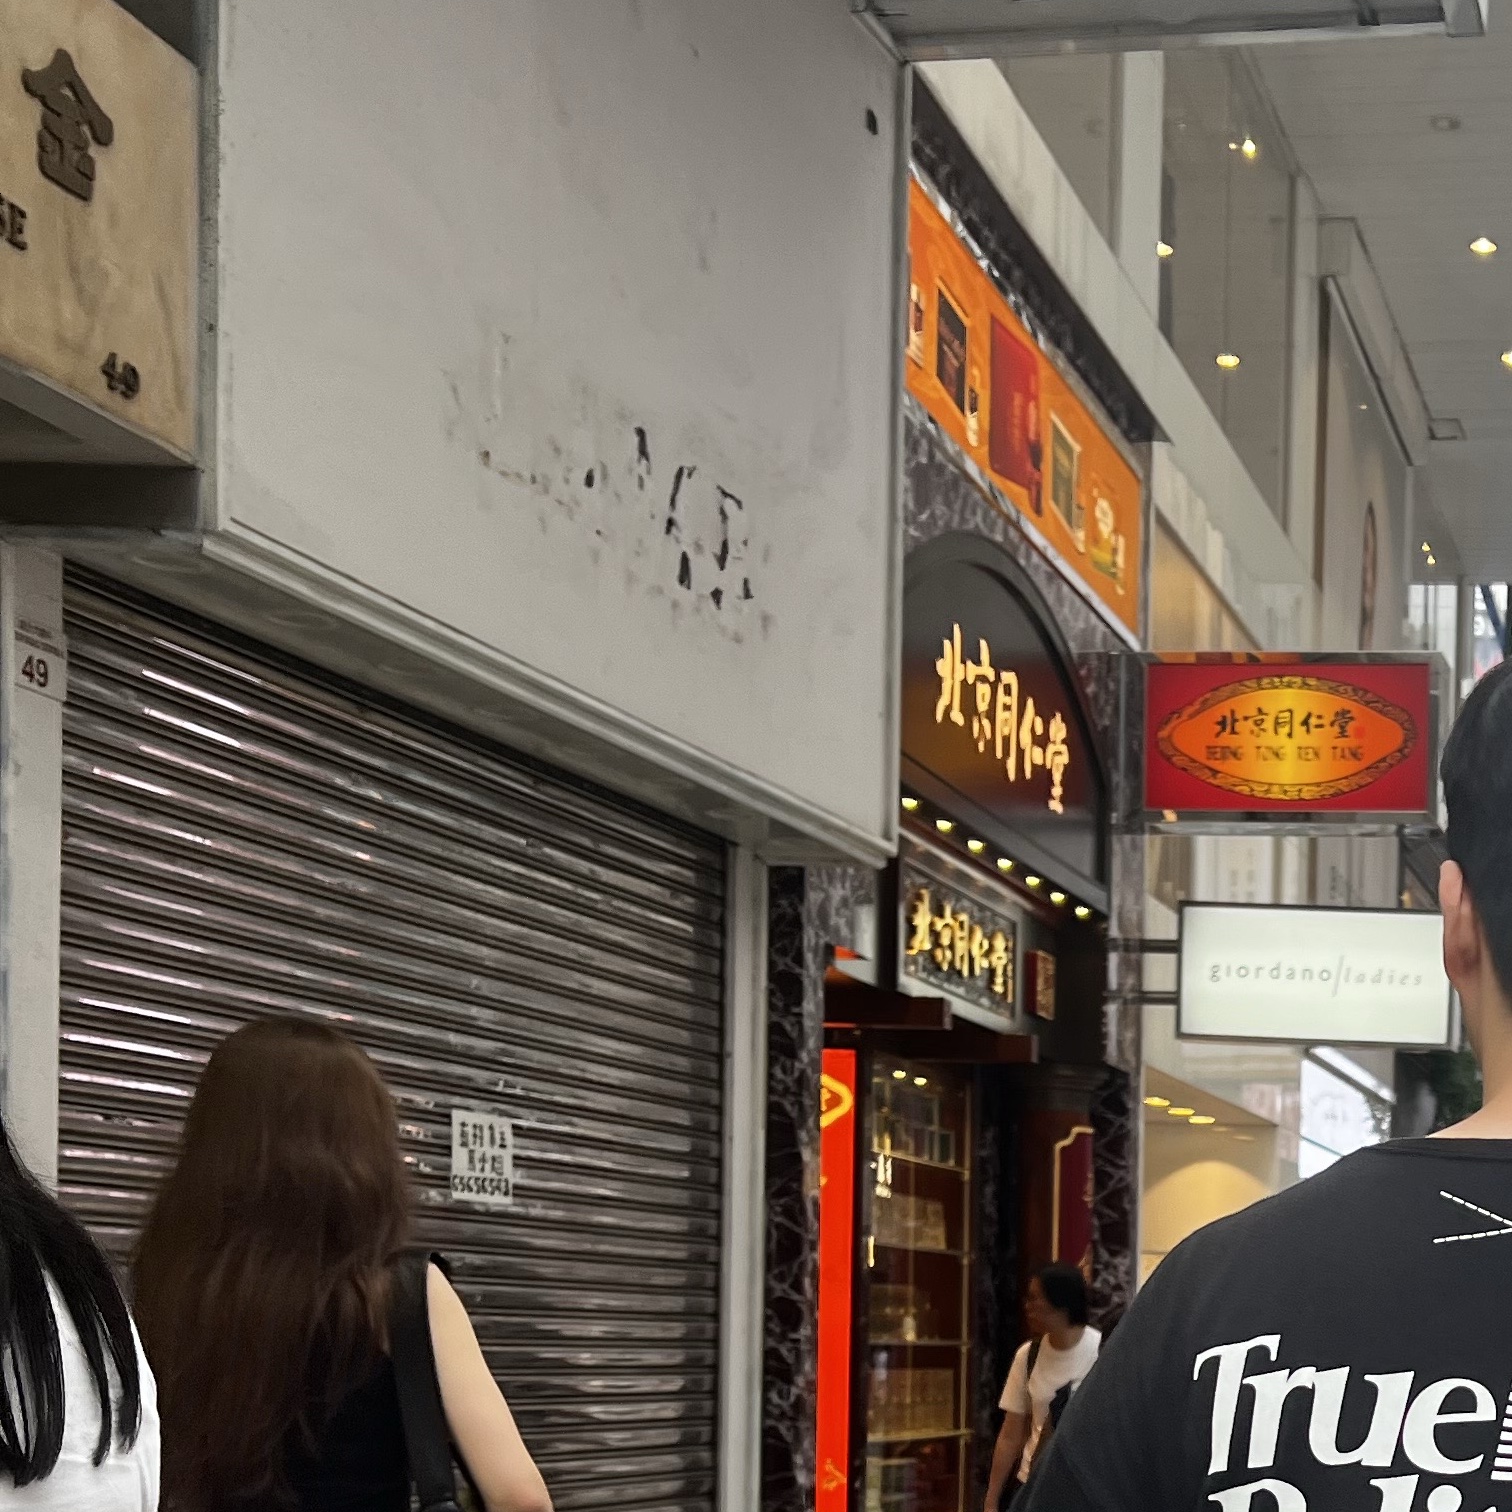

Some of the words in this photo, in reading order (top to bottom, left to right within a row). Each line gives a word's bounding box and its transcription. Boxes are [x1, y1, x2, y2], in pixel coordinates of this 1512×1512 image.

[100, 351, 141, 400] 49
[21, 653, 49, 689] 49
[1193, 1334, 1498, 1475] True
